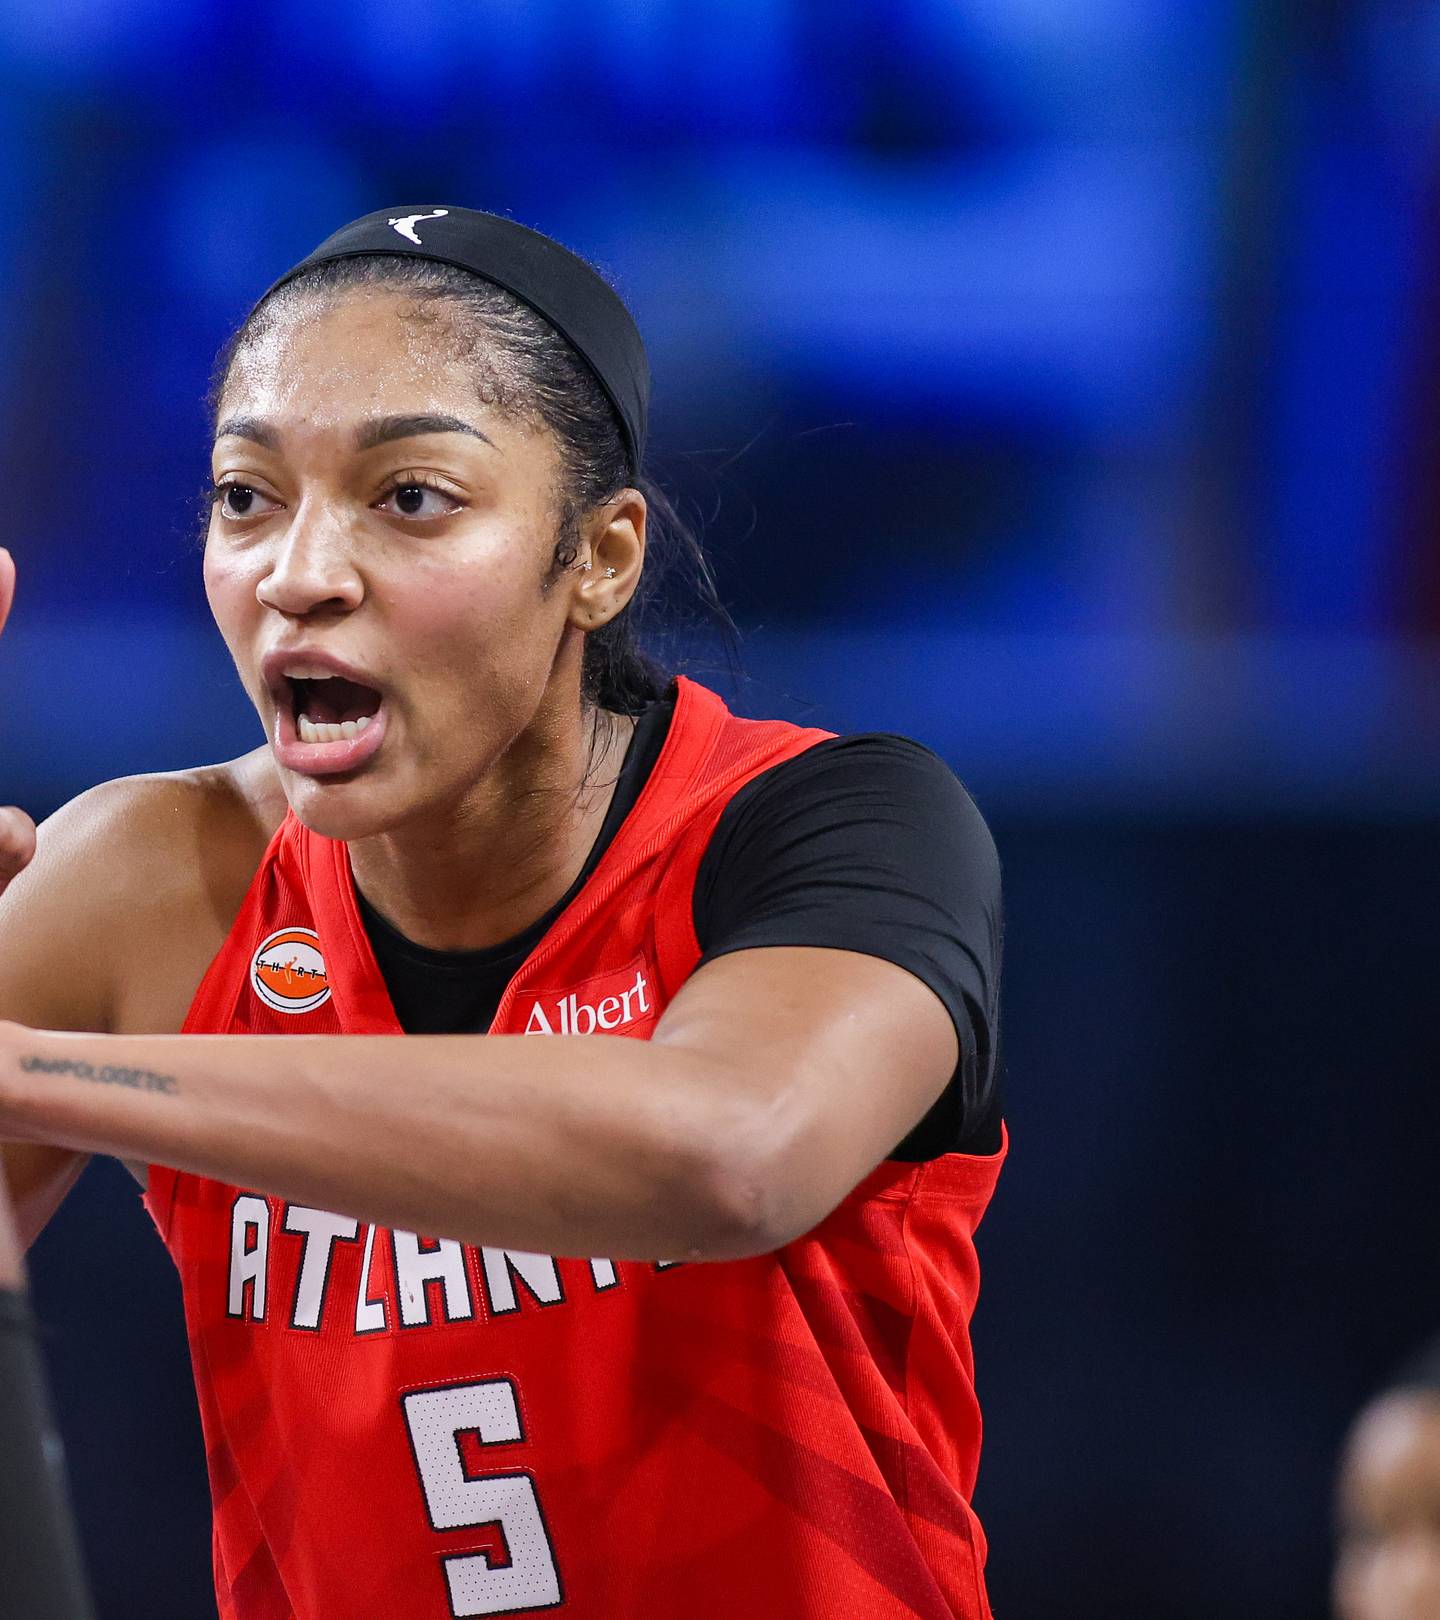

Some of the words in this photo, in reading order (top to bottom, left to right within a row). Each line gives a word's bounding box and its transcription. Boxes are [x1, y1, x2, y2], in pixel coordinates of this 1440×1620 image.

[524, 971, 650, 1036] Albert
[227, 1193, 676, 1335] ATLAN
[400, 1377, 566, 1619] 5
